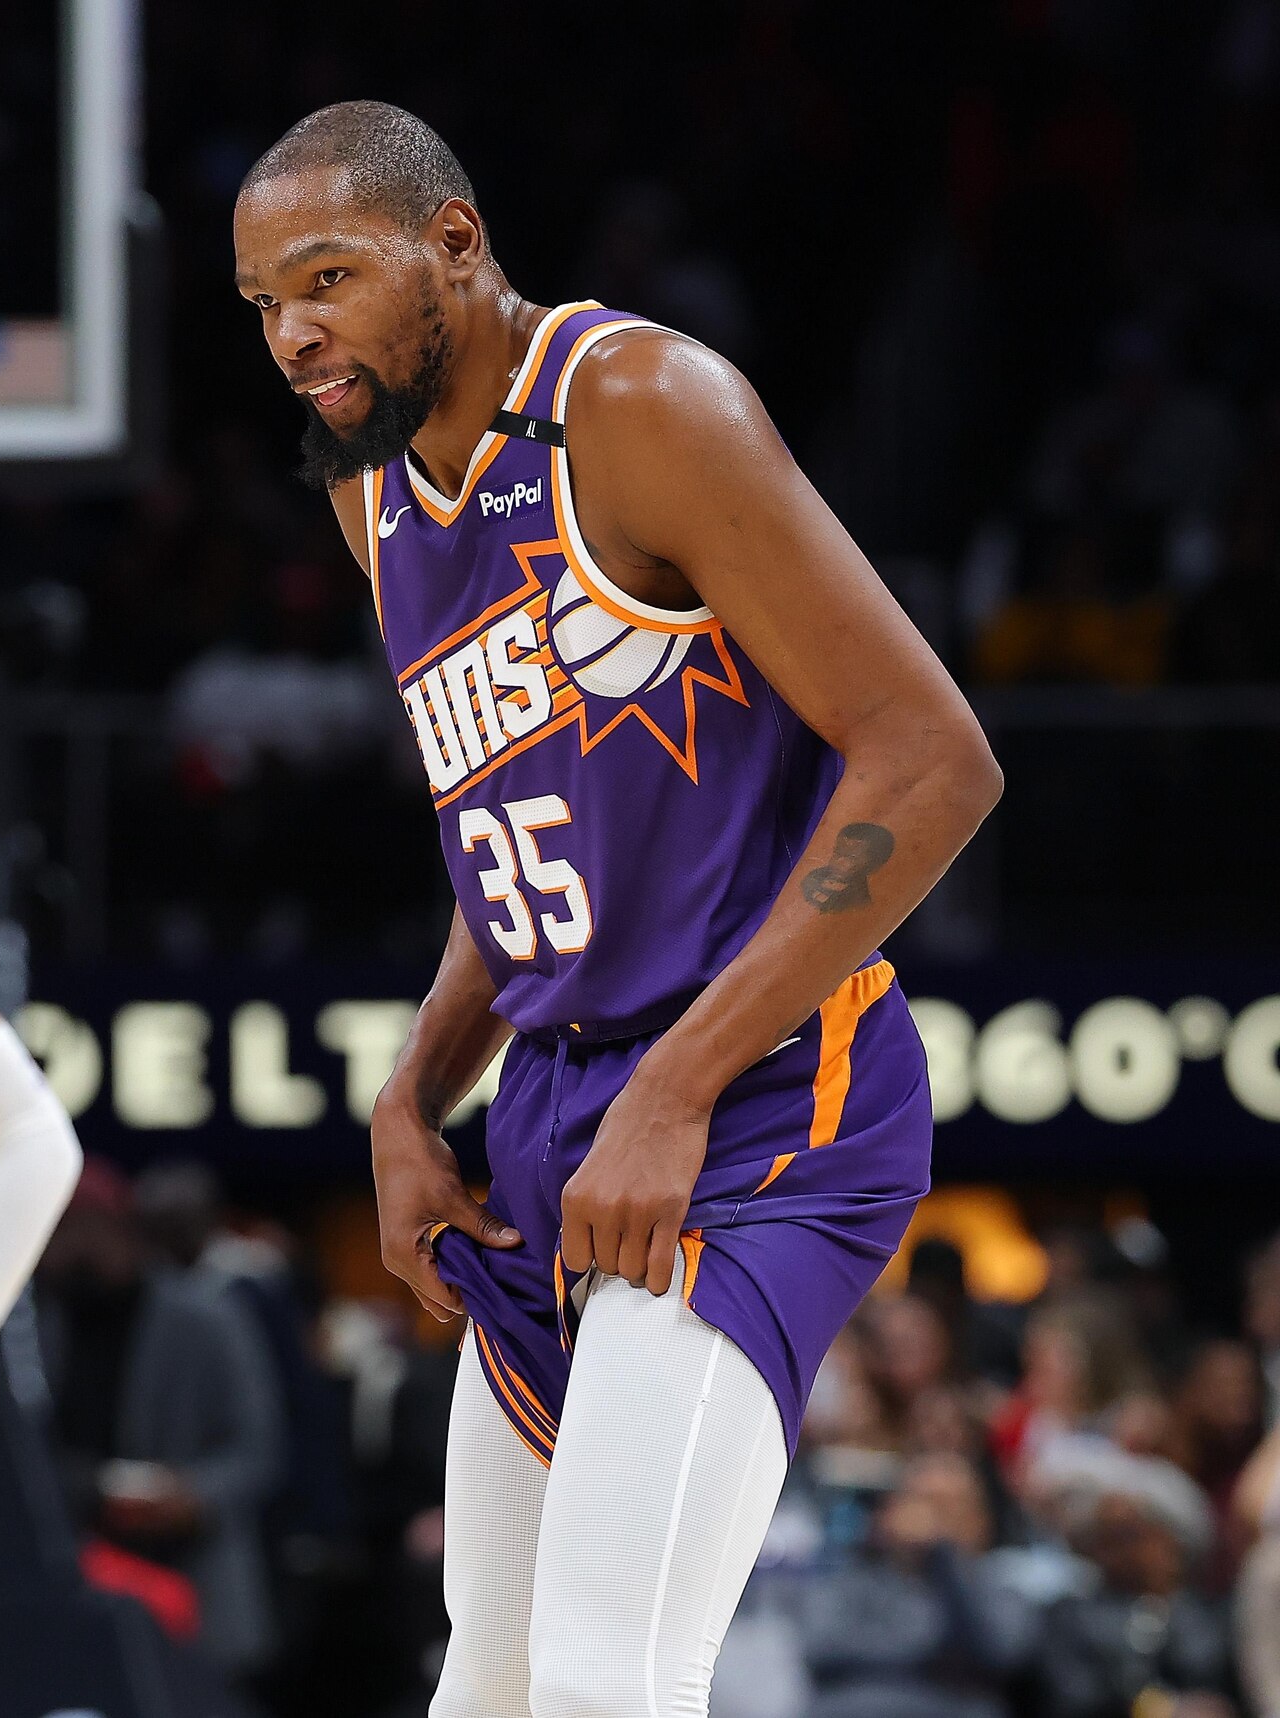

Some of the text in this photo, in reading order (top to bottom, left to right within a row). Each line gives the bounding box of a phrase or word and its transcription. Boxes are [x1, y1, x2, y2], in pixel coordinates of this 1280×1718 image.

[525, 420, 537, 438] AL
[478, 477, 542, 519] PayPal
[403, 610, 552, 793] UNS
[458, 794, 594, 961] 35
[14, 1000, 504, 1130] DELT
